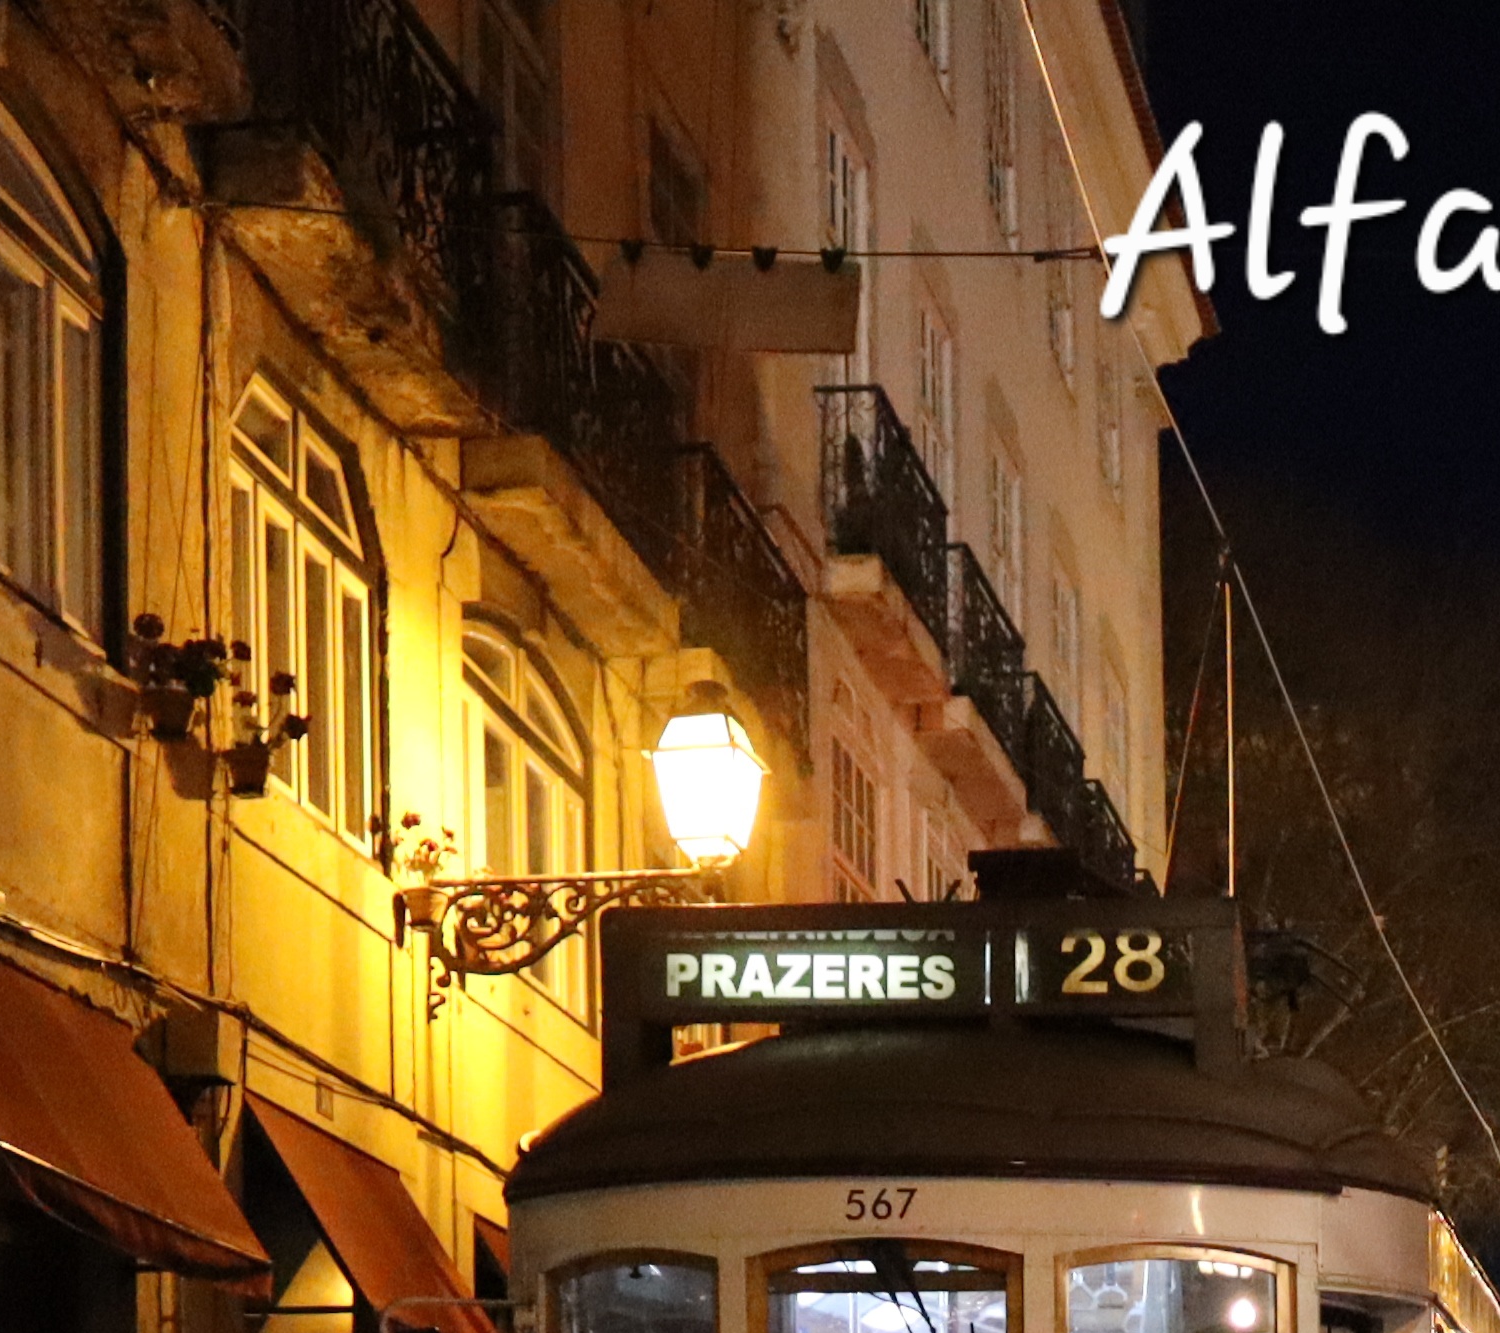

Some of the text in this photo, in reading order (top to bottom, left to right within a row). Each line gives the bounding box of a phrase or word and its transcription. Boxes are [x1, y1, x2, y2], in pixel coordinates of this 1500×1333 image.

[665, 952, 956, 1001] PRAZERES
[1060, 929, 1167, 995] 28
[845, 1187, 918, 1220] 567
